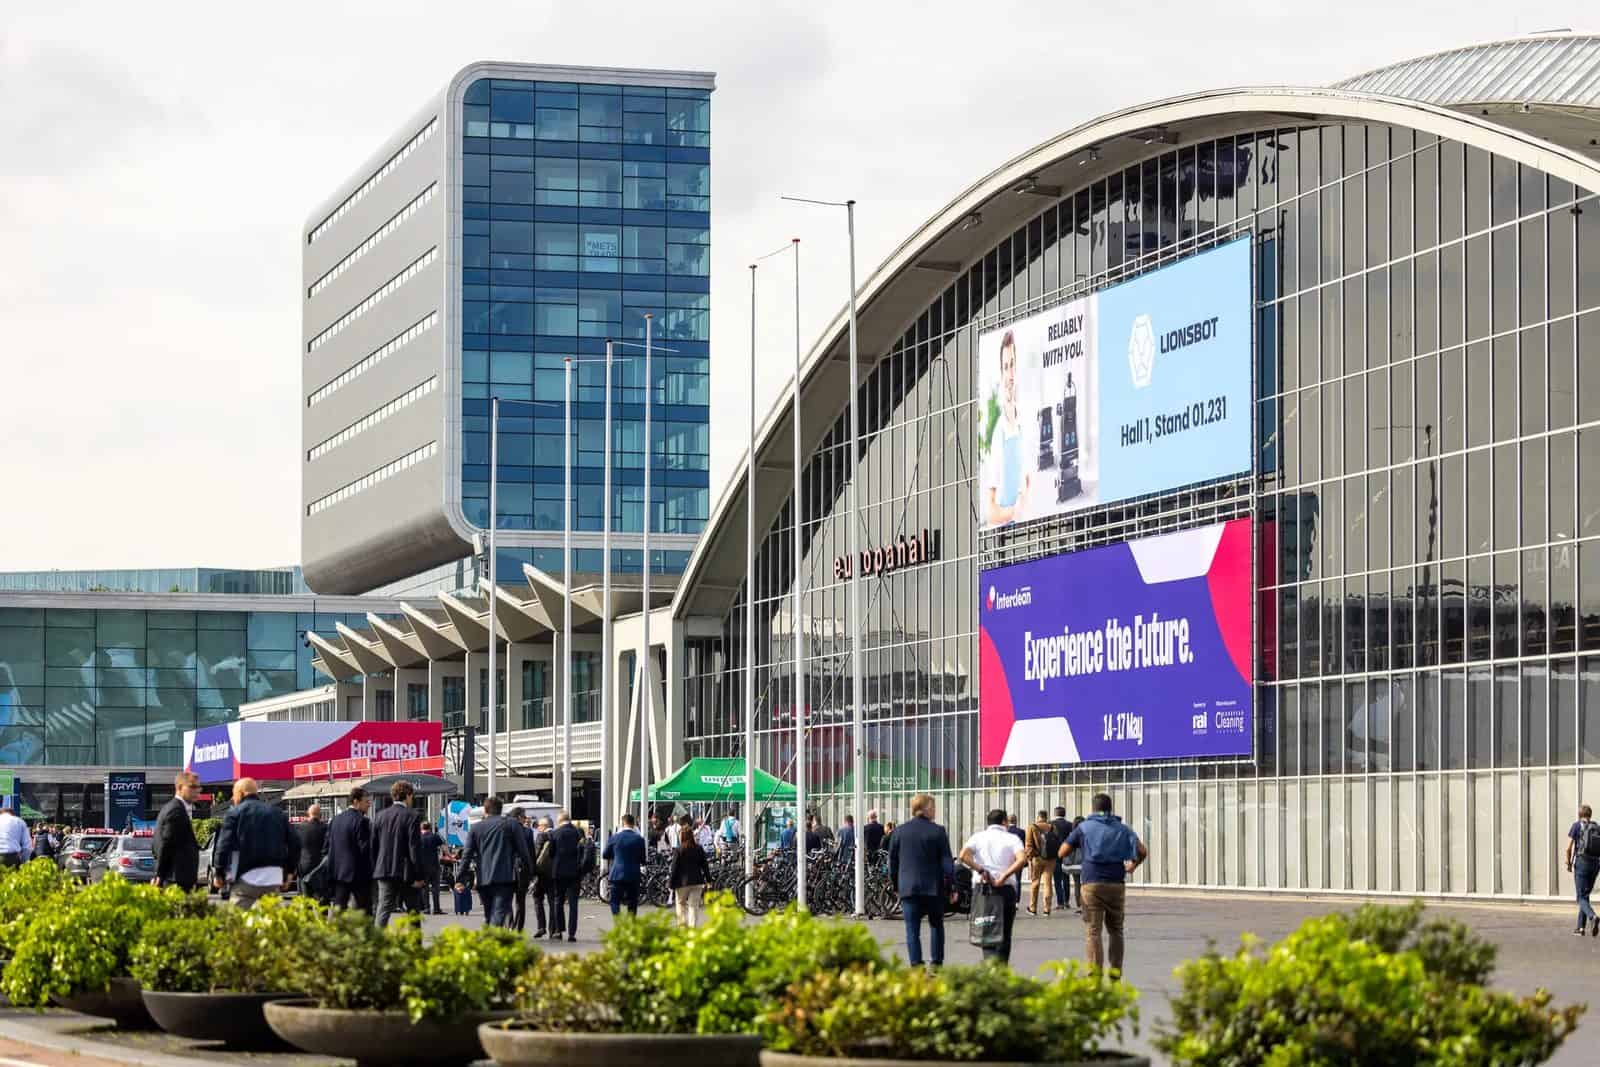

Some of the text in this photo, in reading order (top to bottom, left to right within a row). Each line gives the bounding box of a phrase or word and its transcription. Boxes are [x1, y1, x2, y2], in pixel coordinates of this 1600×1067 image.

[1047, 314, 1083, 342] RELIABLY
[1160, 316, 1219, 354] LIONSBOT
[1042, 339, 1084, 369] WITH YOU.
[1120, 395, 1227, 447] Hall 1, Stand 01.231
[996, 587, 1032, 609] Interclean
[1024, 612, 1194, 691] Experience the Future.
[1126, 711, 1143, 745] May
[1215, 711, 1244, 732] Cleaning
[351, 739, 429, 760] Entrance K
